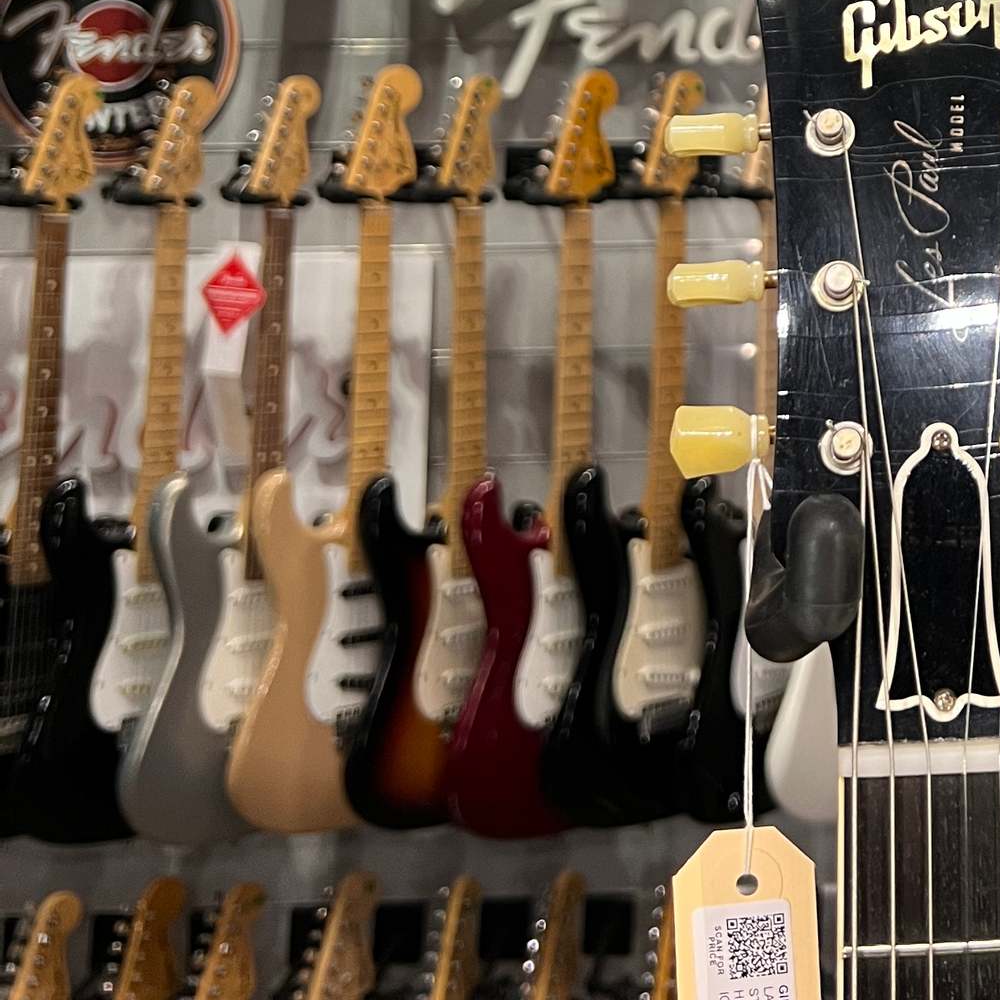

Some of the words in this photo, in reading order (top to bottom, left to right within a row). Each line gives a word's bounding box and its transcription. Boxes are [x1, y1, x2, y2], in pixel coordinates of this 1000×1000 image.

[949, 94, 965, 153] MODEL
[883, 120, 950, 238] Paul
[708, 936, 717, 966] PRICE
[714, 925, 722, 951] SCAN
[717, 953, 725, 975] FOR
